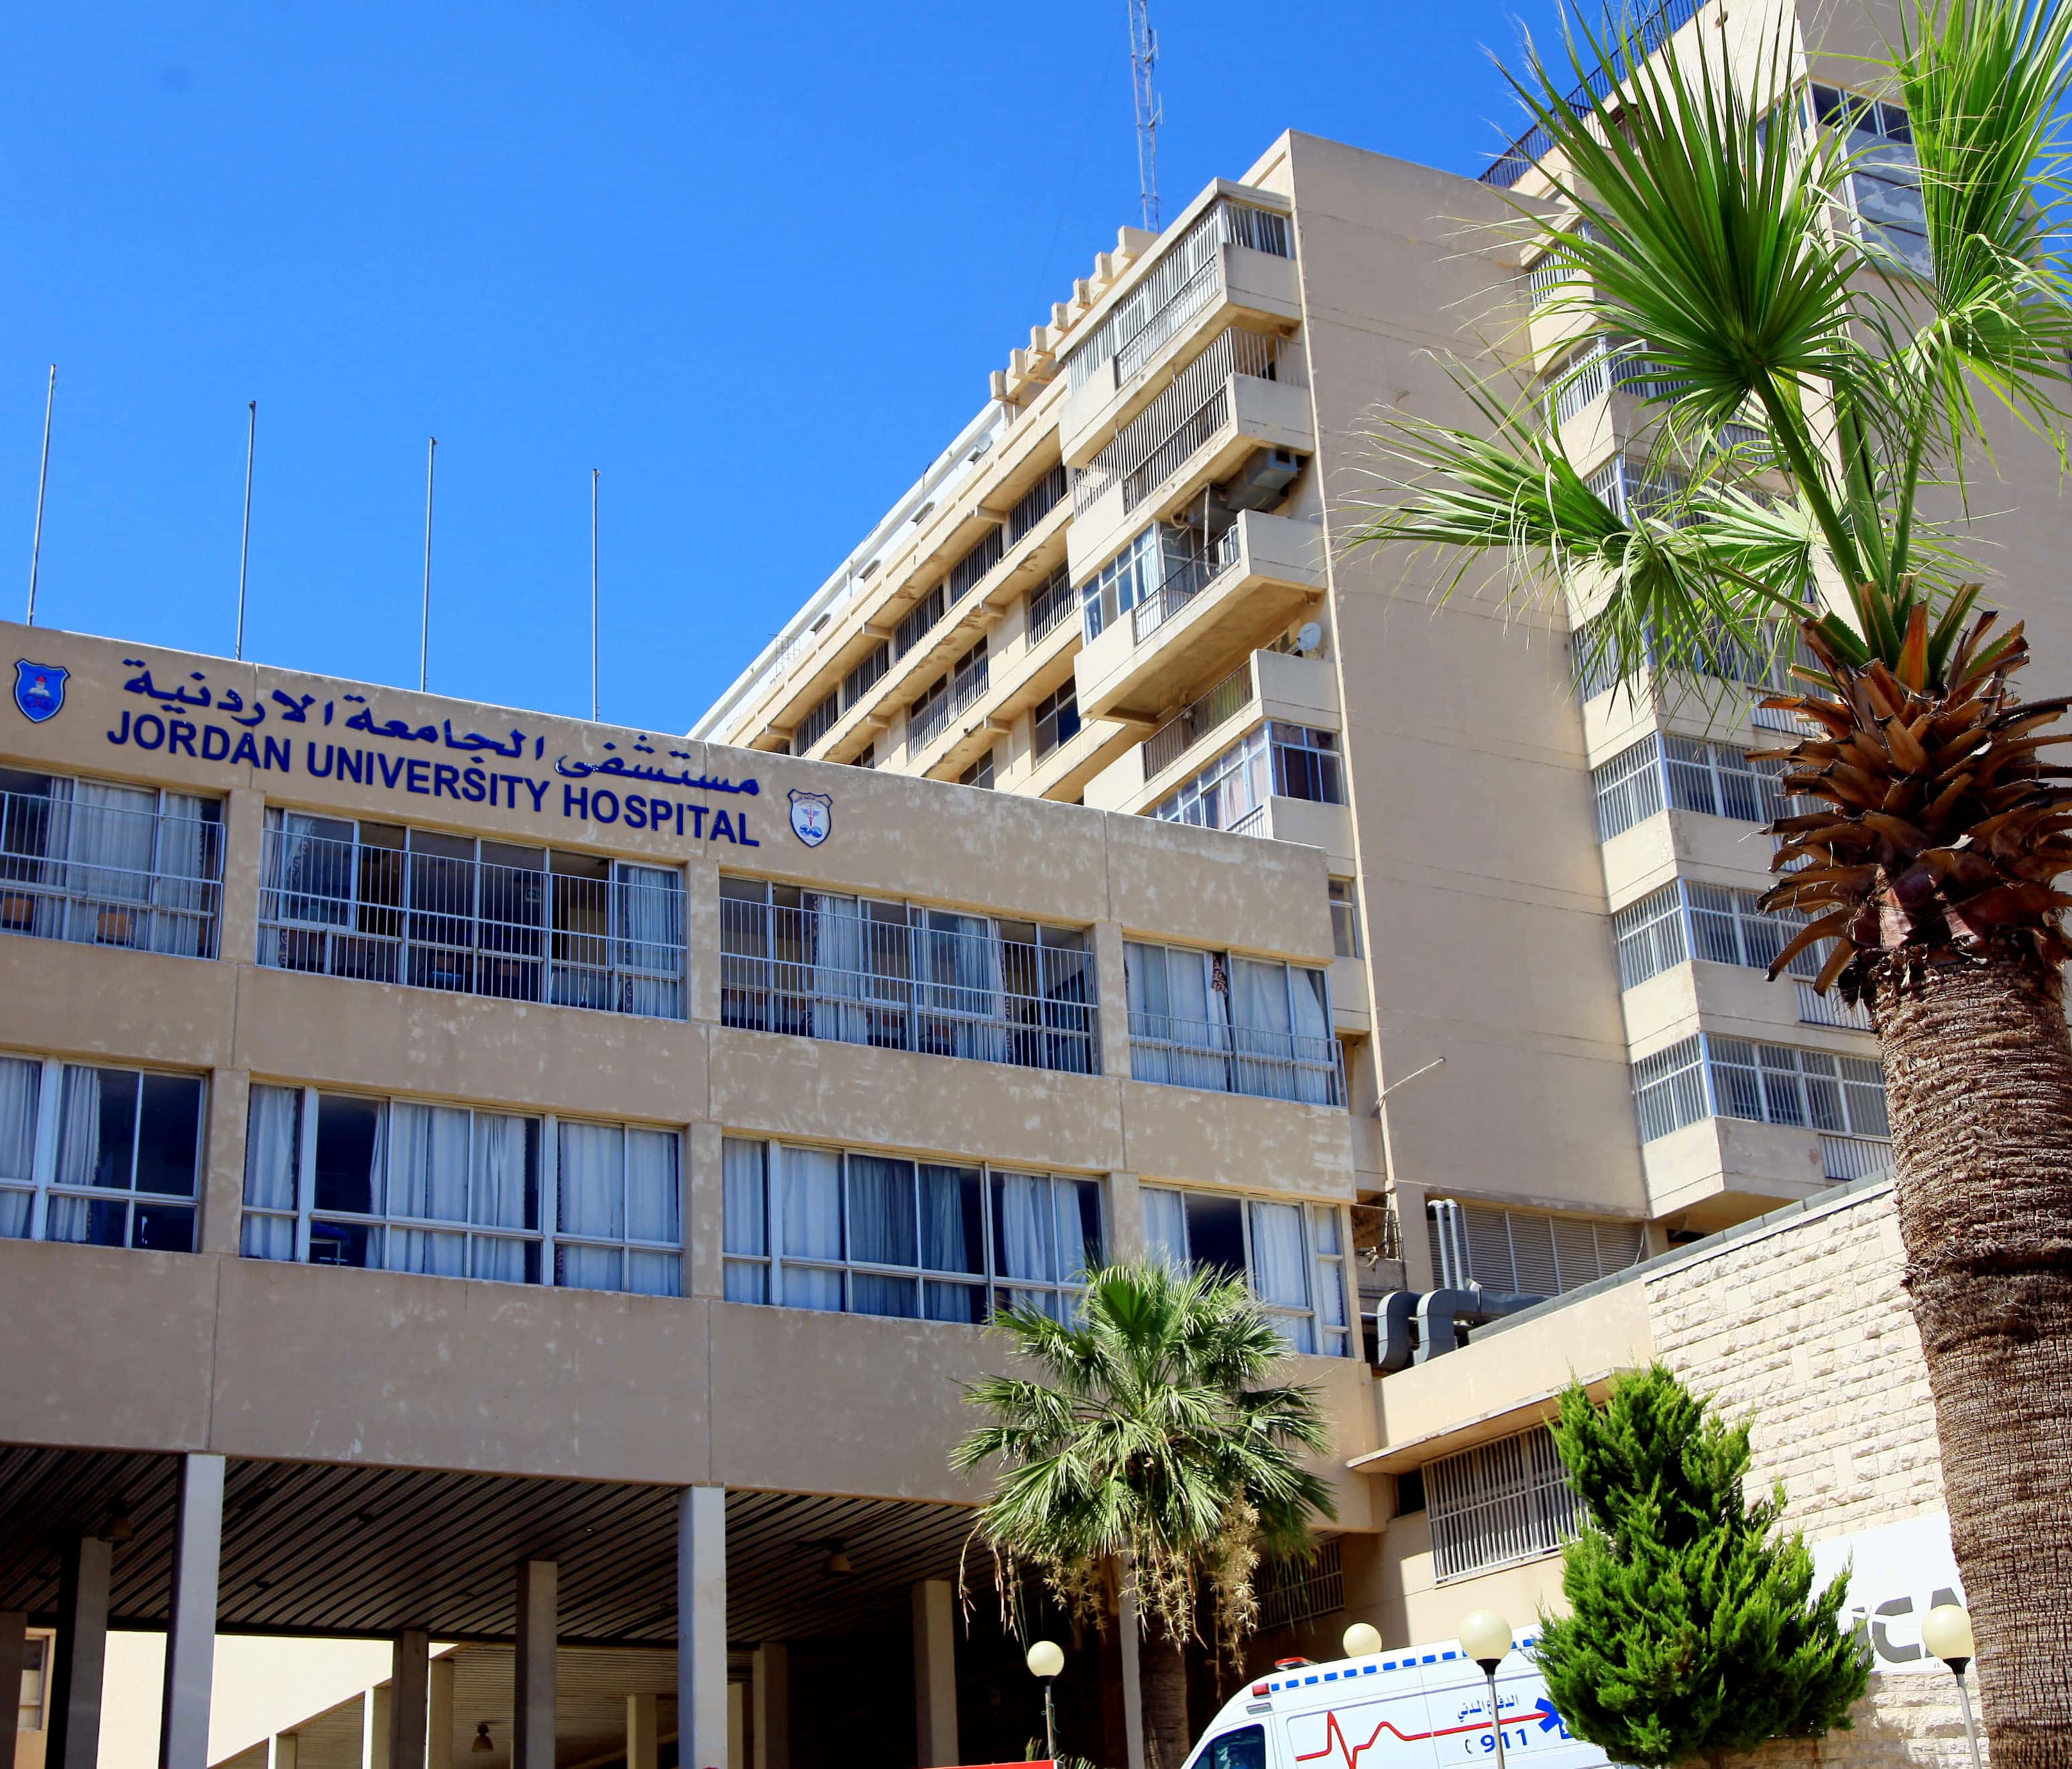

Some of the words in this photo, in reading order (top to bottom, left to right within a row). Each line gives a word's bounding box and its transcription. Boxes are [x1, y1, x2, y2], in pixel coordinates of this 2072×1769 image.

[122, 659, 333, 726] الاردنية
[343, 694, 545, 763] الجامعة
[107, 711, 290, 772] JORDAN
[308, 741, 551, 811] UNIVERSITY
[564, 784, 760, 846] HOSPITAL
[555, 734, 760, 796] مستشفى
[1487, 1694, 1519, 1715] الدفع
[1481, 1729, 1528, 1753] 911
